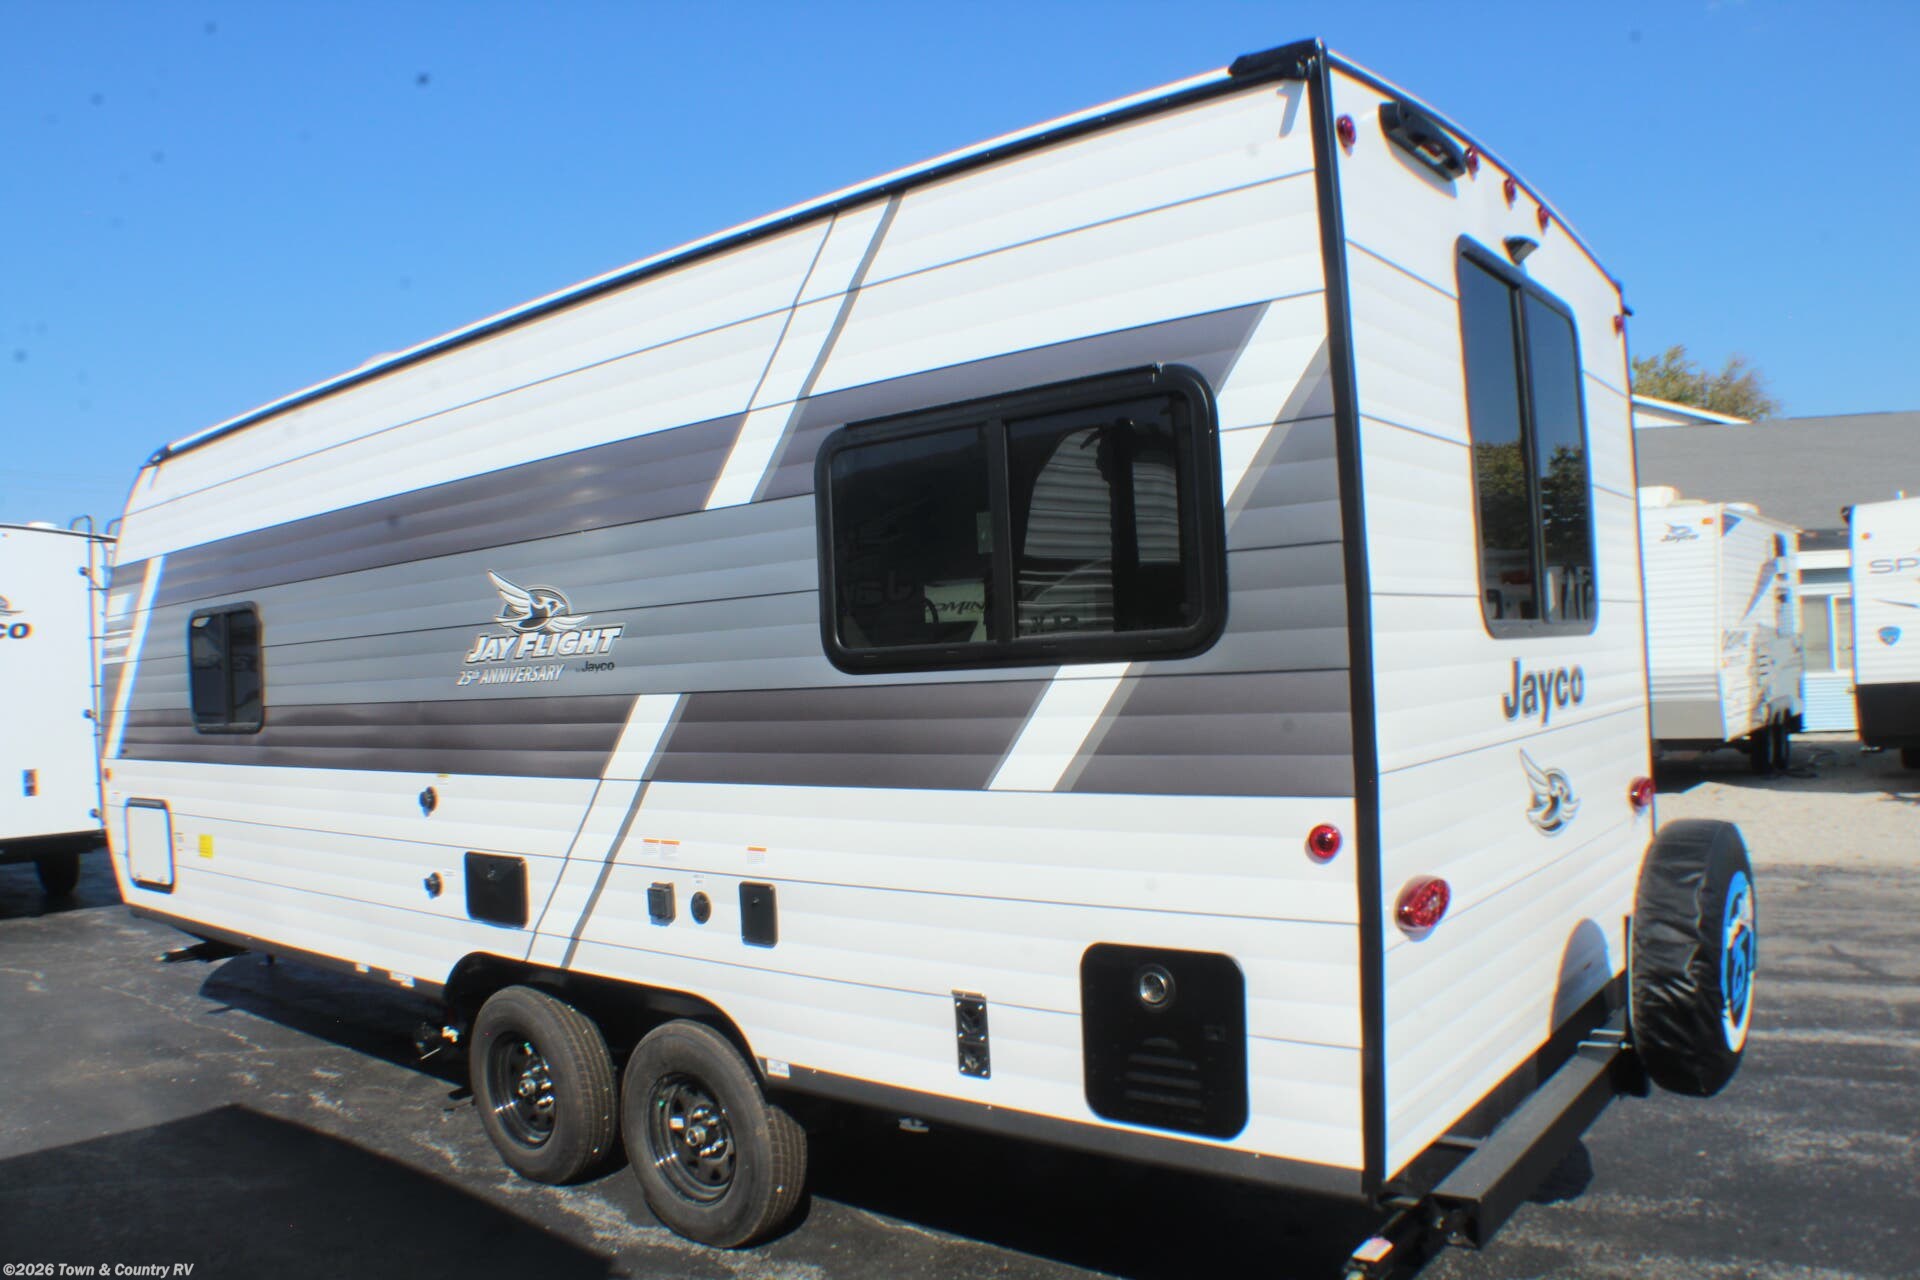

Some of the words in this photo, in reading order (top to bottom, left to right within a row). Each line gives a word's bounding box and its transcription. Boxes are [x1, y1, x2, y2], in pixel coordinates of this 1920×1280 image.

[465, 634, 518, 663] JAY
[515, 626, 623, 659] FLIGHT
[478, 664, 565, 684] ANNIVERSARY
[581, 660, 615, 674] Jayco
[1502, 657, 1584, 726] Jayco
